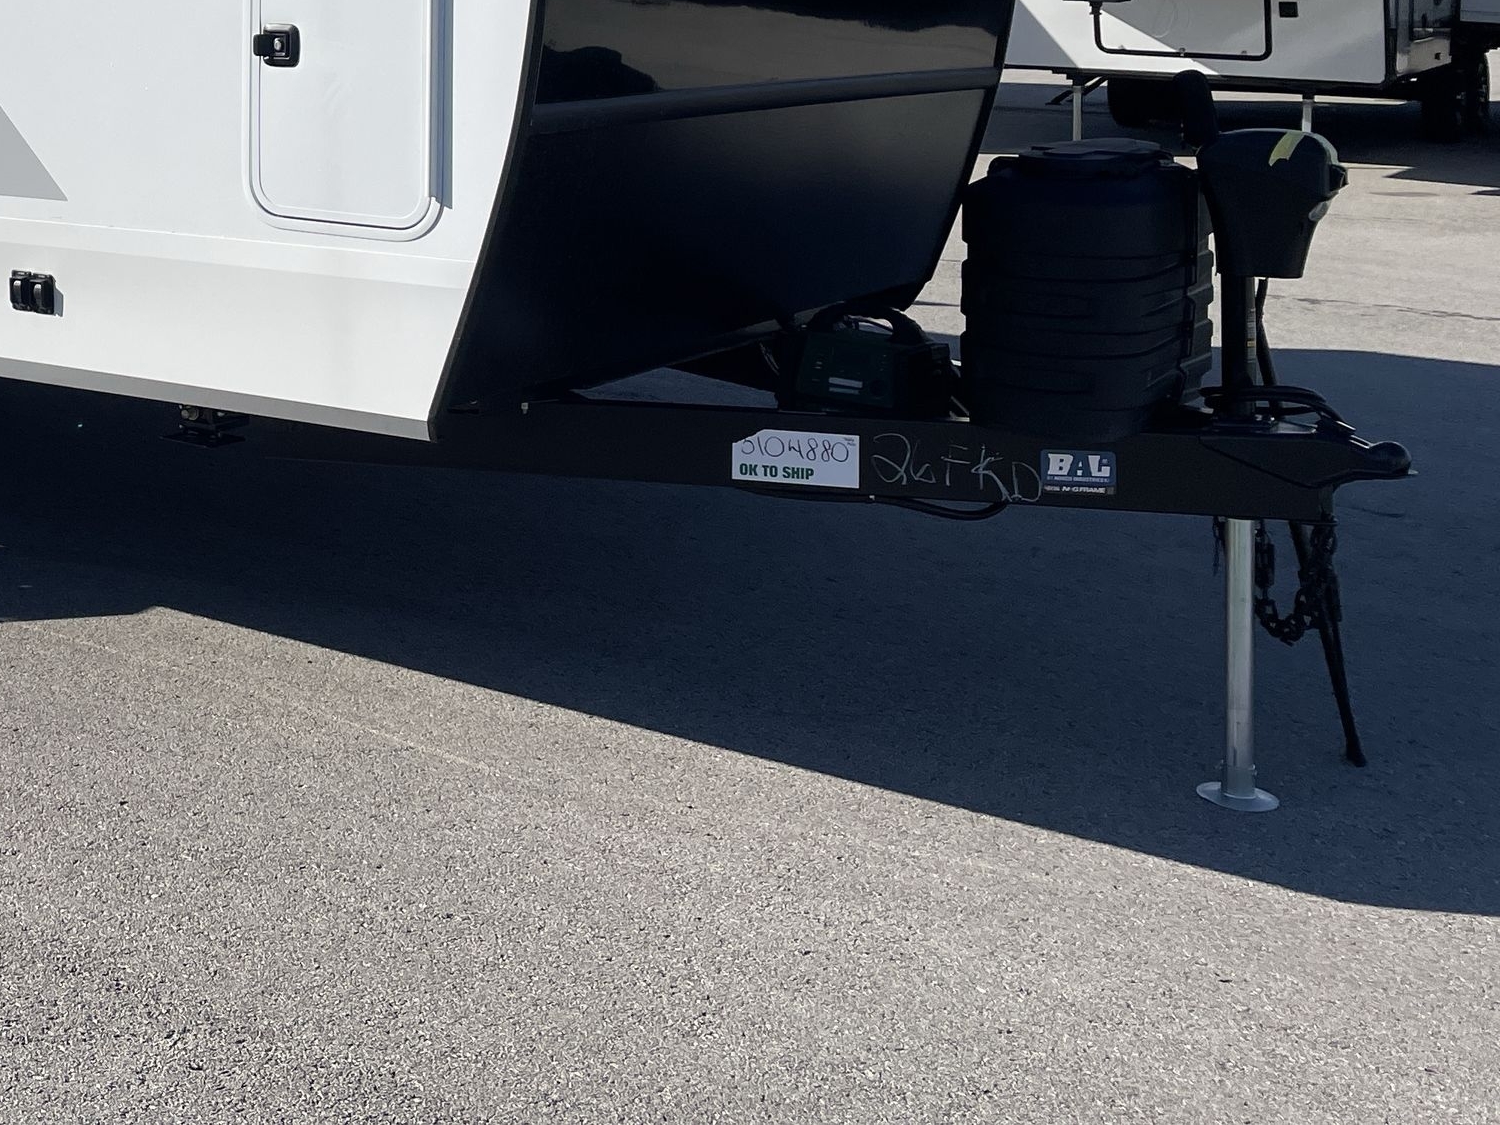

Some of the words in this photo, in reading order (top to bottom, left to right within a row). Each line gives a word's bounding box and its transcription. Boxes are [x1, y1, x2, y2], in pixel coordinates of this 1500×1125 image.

[739, 462, 758, 476] OK
[762, 464, 778, 478] TO
[782, 466, 815, 480] SHIP
